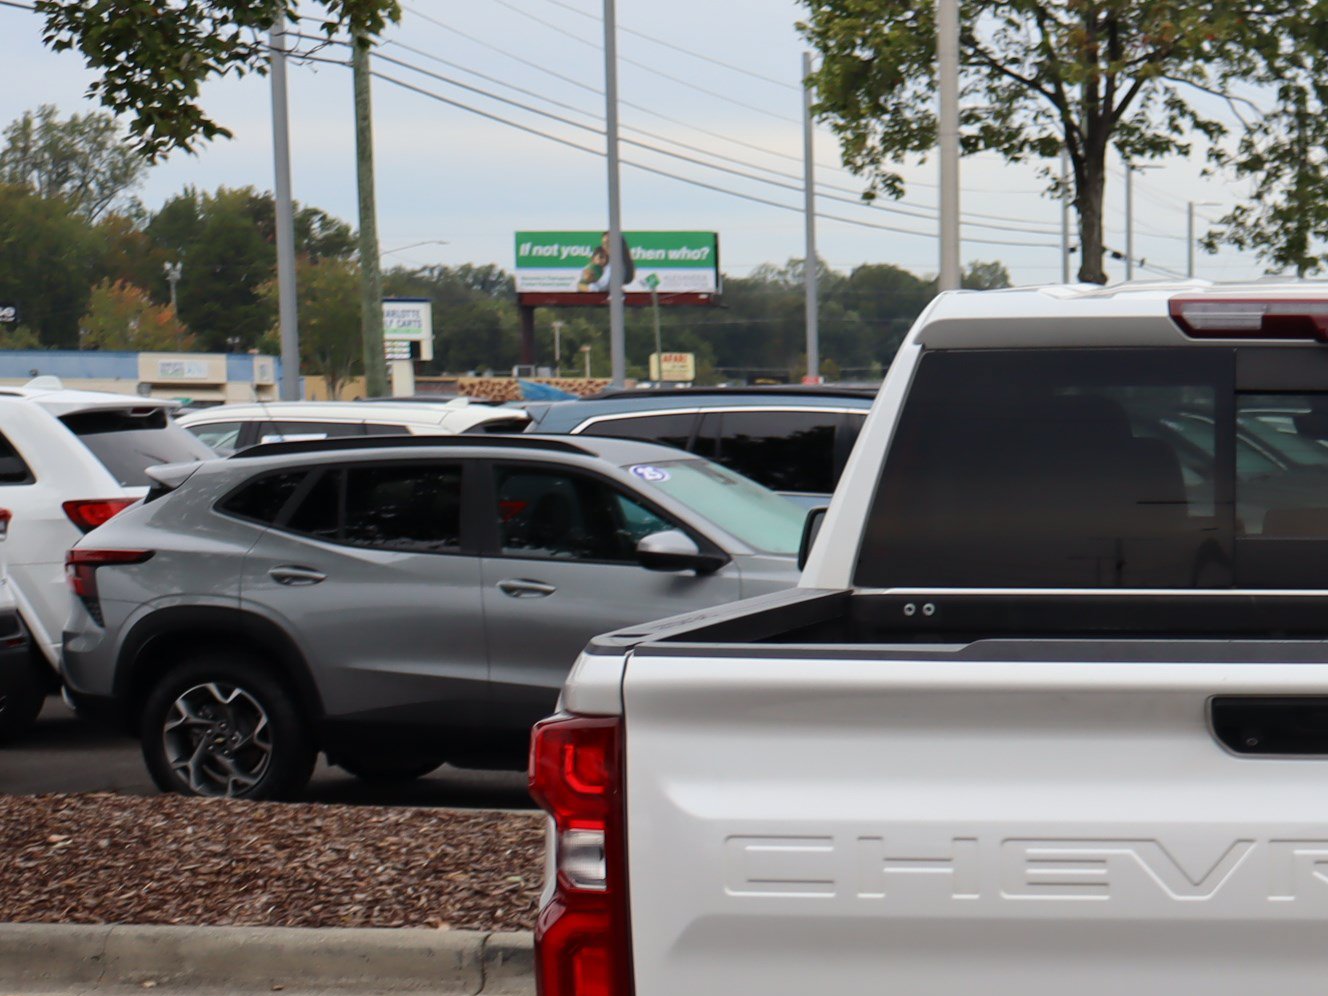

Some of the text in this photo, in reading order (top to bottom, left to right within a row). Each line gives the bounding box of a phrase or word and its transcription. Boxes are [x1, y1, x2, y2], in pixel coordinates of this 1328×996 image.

[519, 242, 710, 260] If not you, then who?
